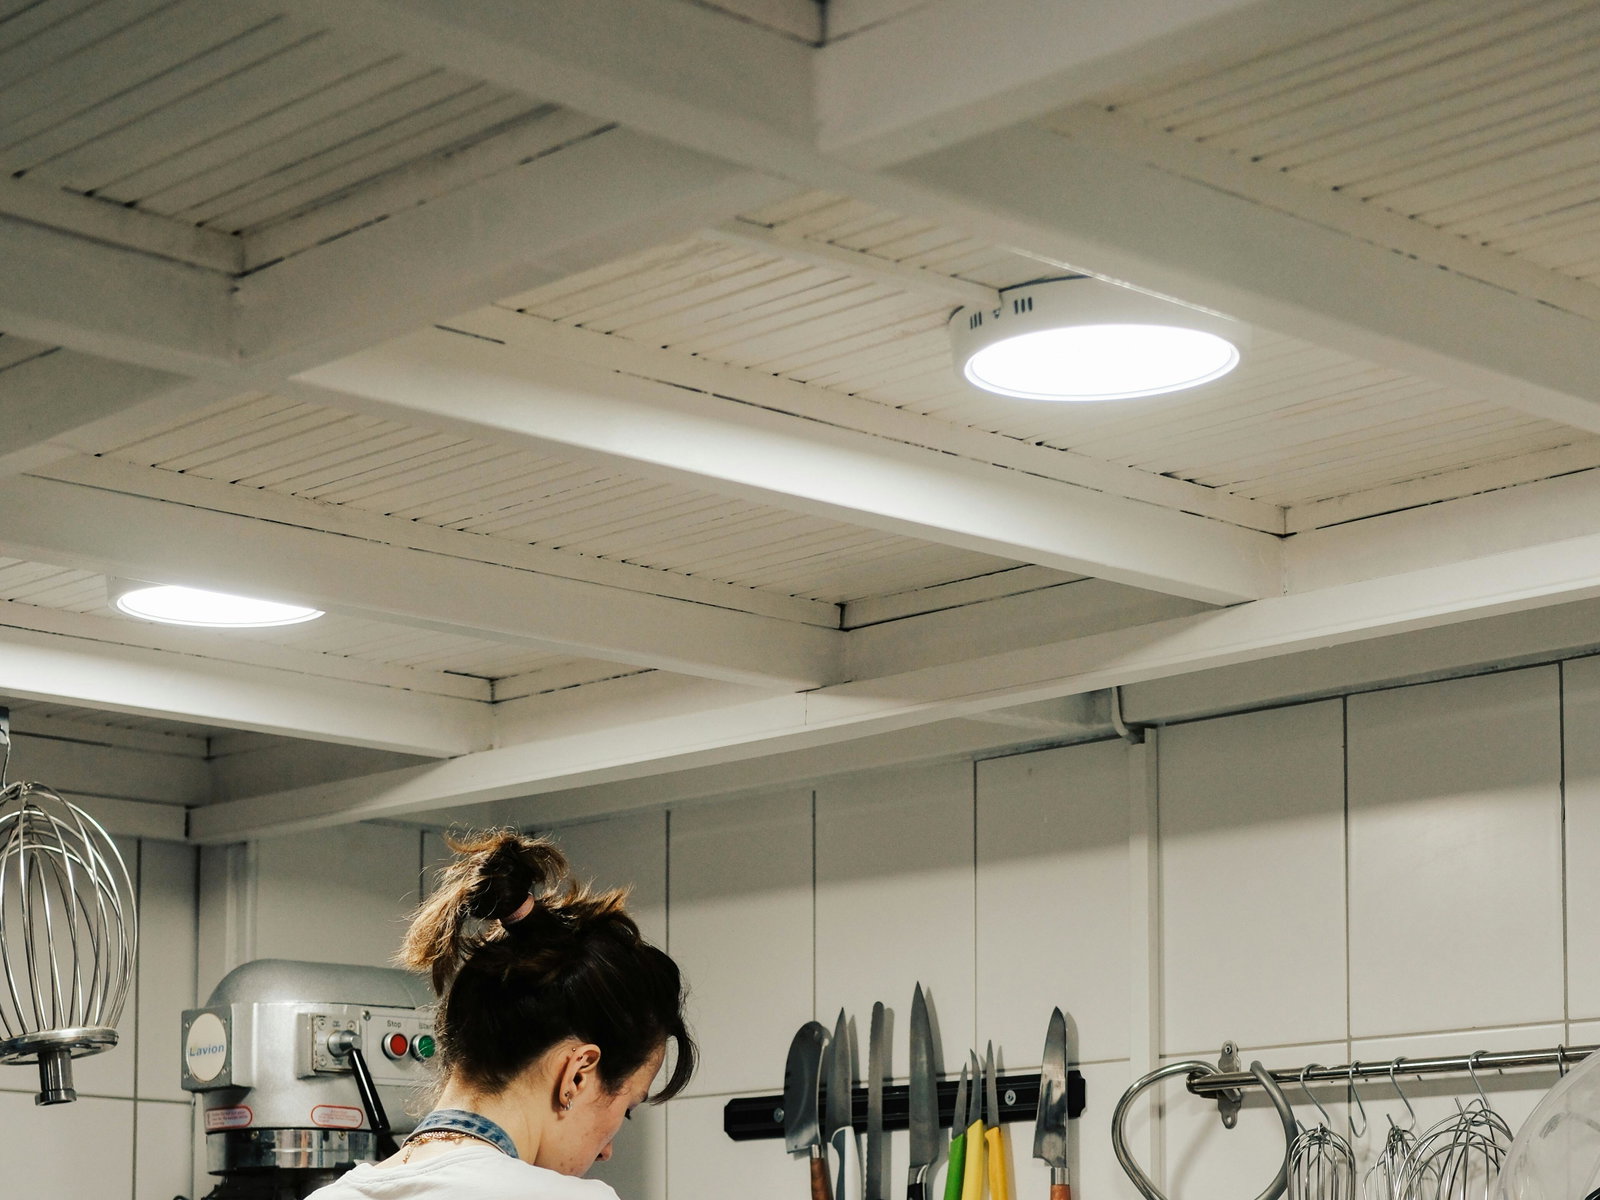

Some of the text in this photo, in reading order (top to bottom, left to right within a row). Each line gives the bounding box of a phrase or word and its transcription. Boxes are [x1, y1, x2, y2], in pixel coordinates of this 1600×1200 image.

[387, 1020, 402, 1029] Stop
[419, 1022, 434, 1030] Star
[189, 1044, 225, 1057] Lavion
